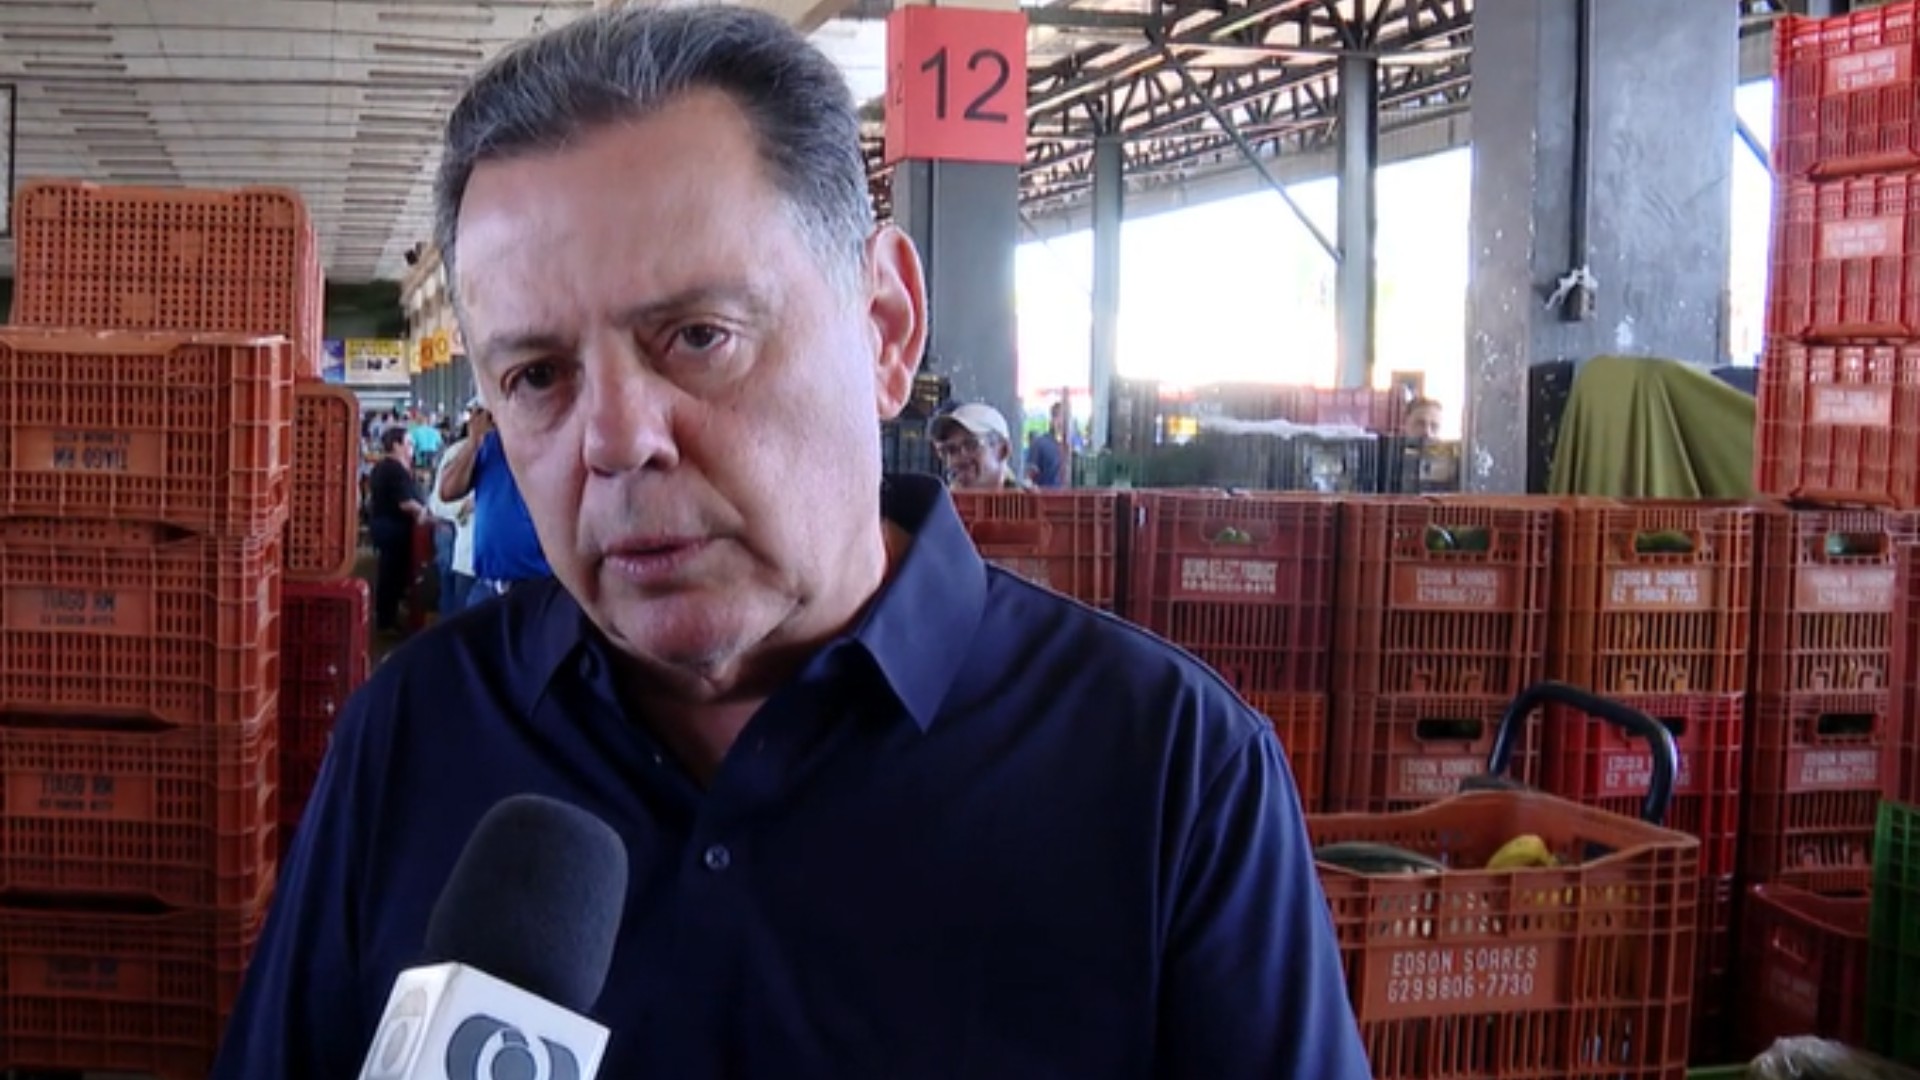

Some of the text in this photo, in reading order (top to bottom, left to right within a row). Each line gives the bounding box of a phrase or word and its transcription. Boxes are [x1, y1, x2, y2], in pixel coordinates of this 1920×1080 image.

[920, 46, 1010, 123] 12
[1391, 947, 1539, 977] EDSON SOARES
